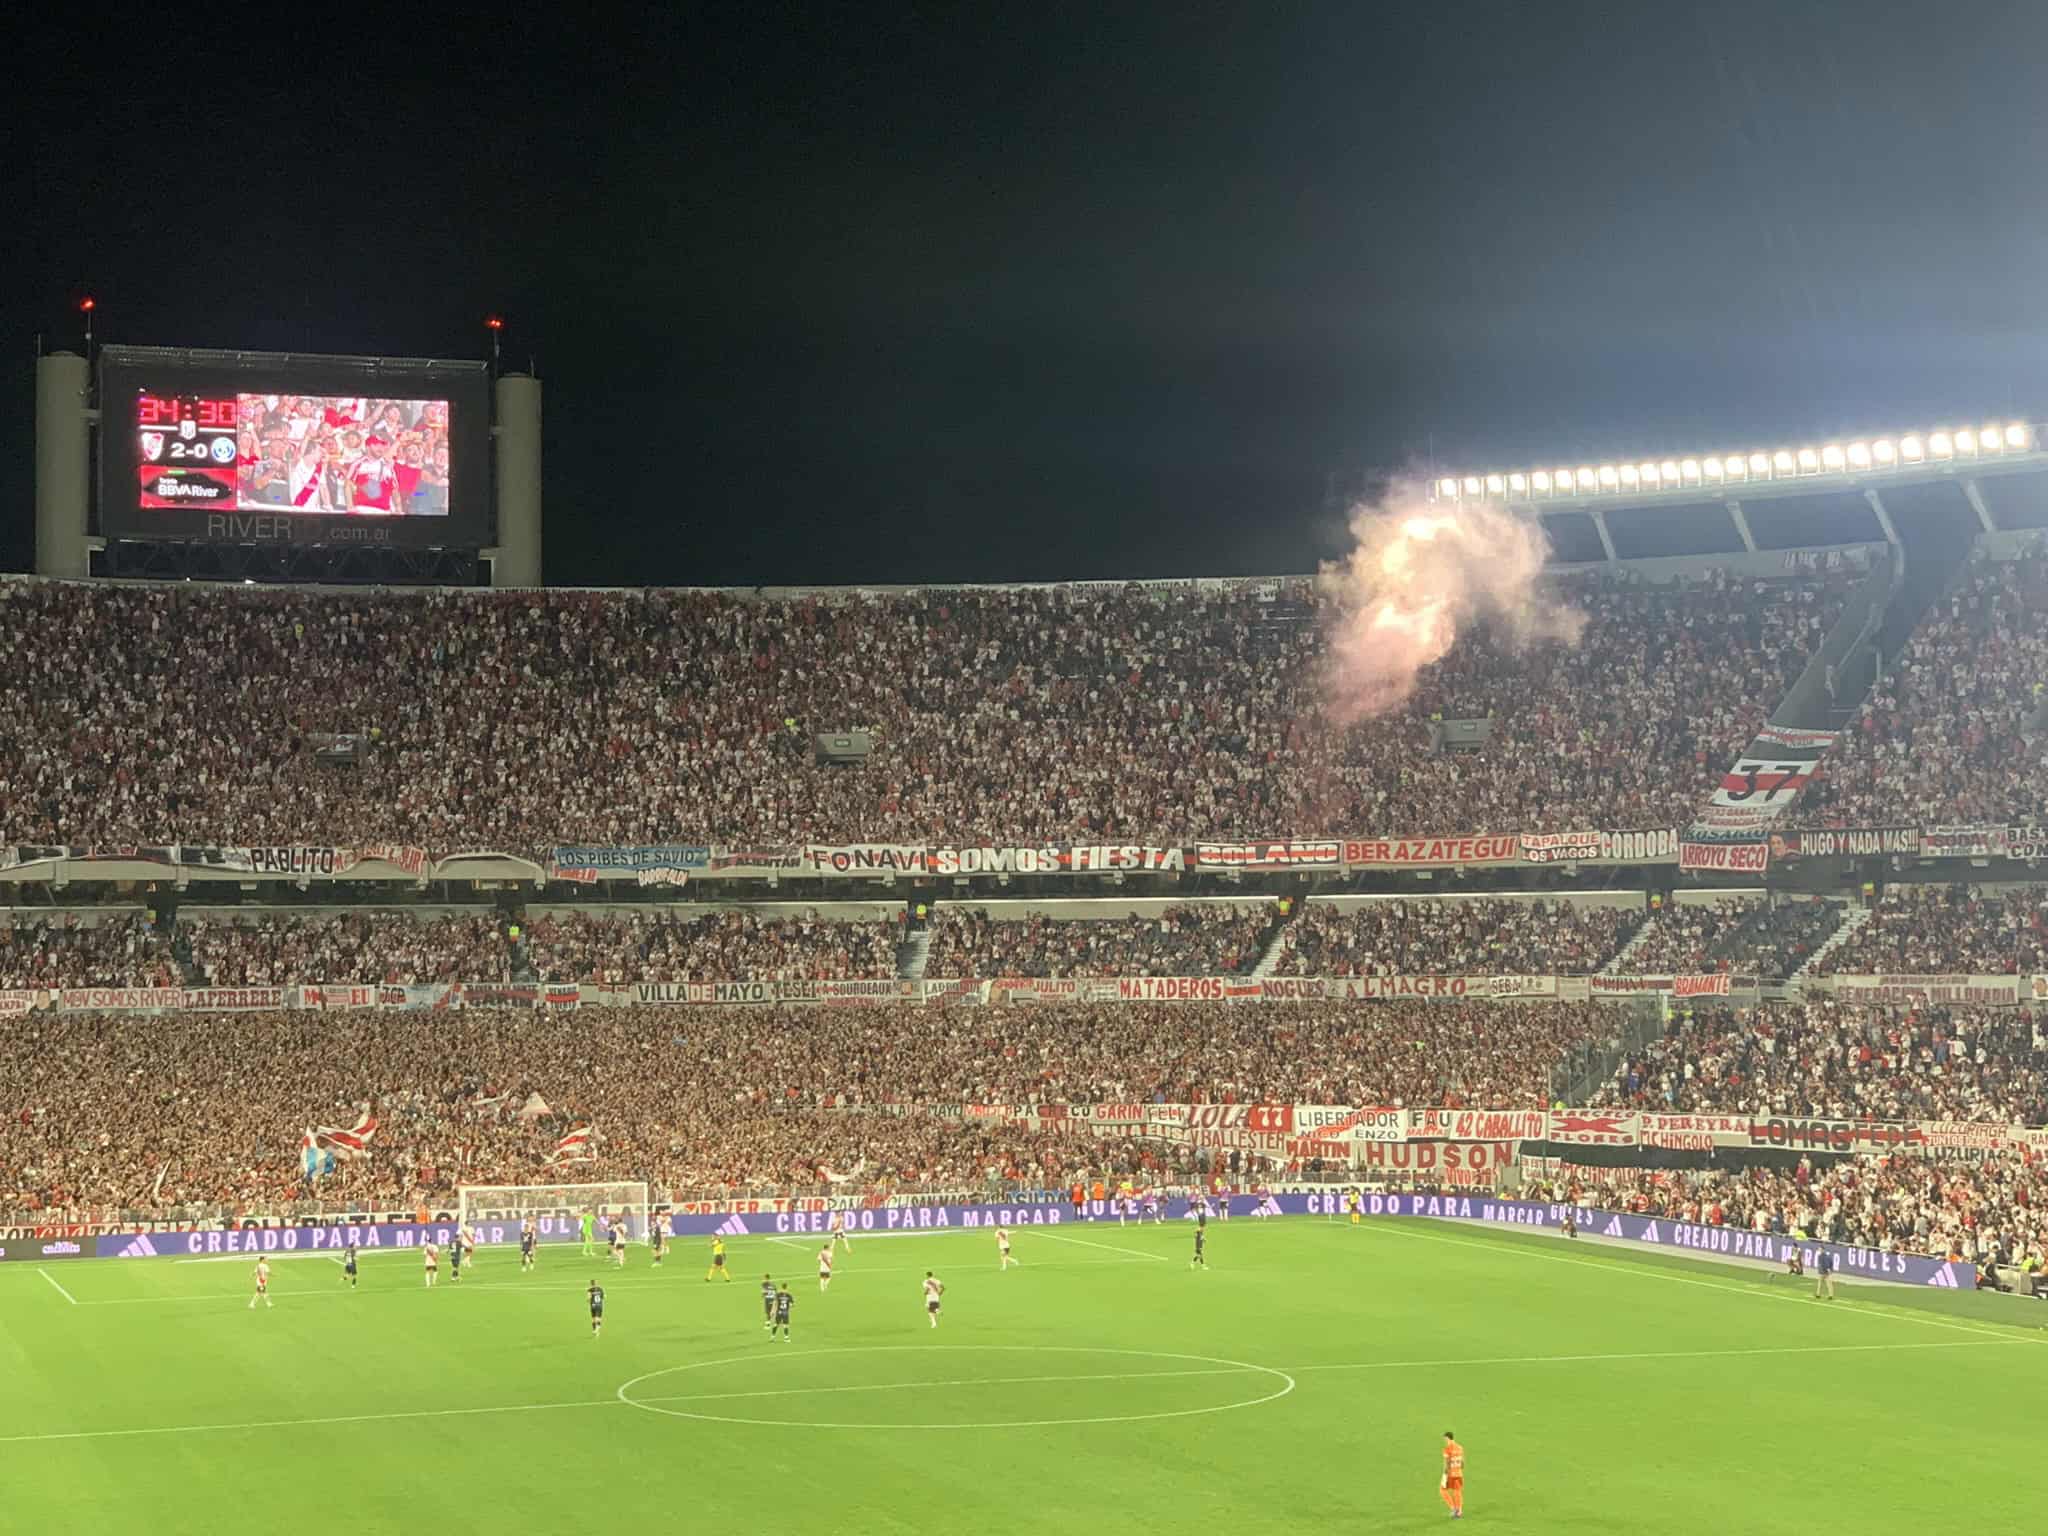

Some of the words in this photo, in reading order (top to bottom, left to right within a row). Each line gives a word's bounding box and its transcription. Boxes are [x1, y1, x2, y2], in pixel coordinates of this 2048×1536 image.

[139, 399, 237, 424] 34:30
[170, 442, 208, 459] 2-0
[158, 484, 192, 496] BBVA
[192, 485, 220, 498] River
[207, 515, 292, 539] RIVER
[1727, 764, 1802, 801] 37
[1199, 843, 1338, 865] SOLANO
[1346, 837, 1515, 864] BERAZATEGUI
[1551, 846, 1597, 860] VAGOS
[1801, 831, 1835, 856] HUGO
[1838, 832, 1847, 854] Y
[1849, 831, 1882, 855] NADA
[250, 848, 335, 874] PABLITO
[558, 852, 585, 867] LOS
[588, 851, 630, 866] PIBES
[633, 850, 650, 865] DE
[654, 849, 695, 864] SAVIO
[813, 849, 927, 872] FONAVI
[937, 846, 1061, 873] SOMOS
[1071, 845, 1185, 872] FIESTA
[1681, 845, 1726, 868] ARROYO
[1729, 846, 1767, 870] SECO
[638, 983, 687, 1001] VILLA
[689, 983, 713, 1000] DE
[714, 982, 764, 1001] MAYO
[1119, 978, 1222, 998] MATADEROS
[1346, 978, 1466, 998] ALMAGRO
[1013, 1104, 1090, 1118] PACHECO
[1096, 1103, 1145, 1120] GARIN
[1257, 1106, 1284, 1128] 77
[1298, 1110, 1400, 1127] LIBERTADOR
[1354, 1128, 1399, 1140] ENZO
[1455, 1111, 1474, 1136] 42
[1475, 1112, 1543, 1139] CABALLITO
[1658, 1116, 1749, 1132] PEREYRA
[1750, 1118, 1851, 1151] LOMAS
[1286, 1139, 1351, 1158] MARTIN
[1367, 1142, 1513, 1169] HUDSON
[776, 1211, 874, 1233] CREADO
[887, 1207, 950, 1229] PARA
[963, 1208, 1061, 1228] MARCAR
[1307, 1196, 1400, 1215] CREADO
[1413, 1196, 1472, 1218] PARA
[1483, 1203, 1544, 1226] MARCAR
[188, 1230, 298, 1253] CREADO
[312, 1226, 381, 1248] PARA
[396, 1226, 505, 1248] MARAR
[1674, 1223, 1729, 1251] CREADO
[1735, 1232, 1774, 1260] PARA
[1848, 1247, 1907, 1274] GOLES
